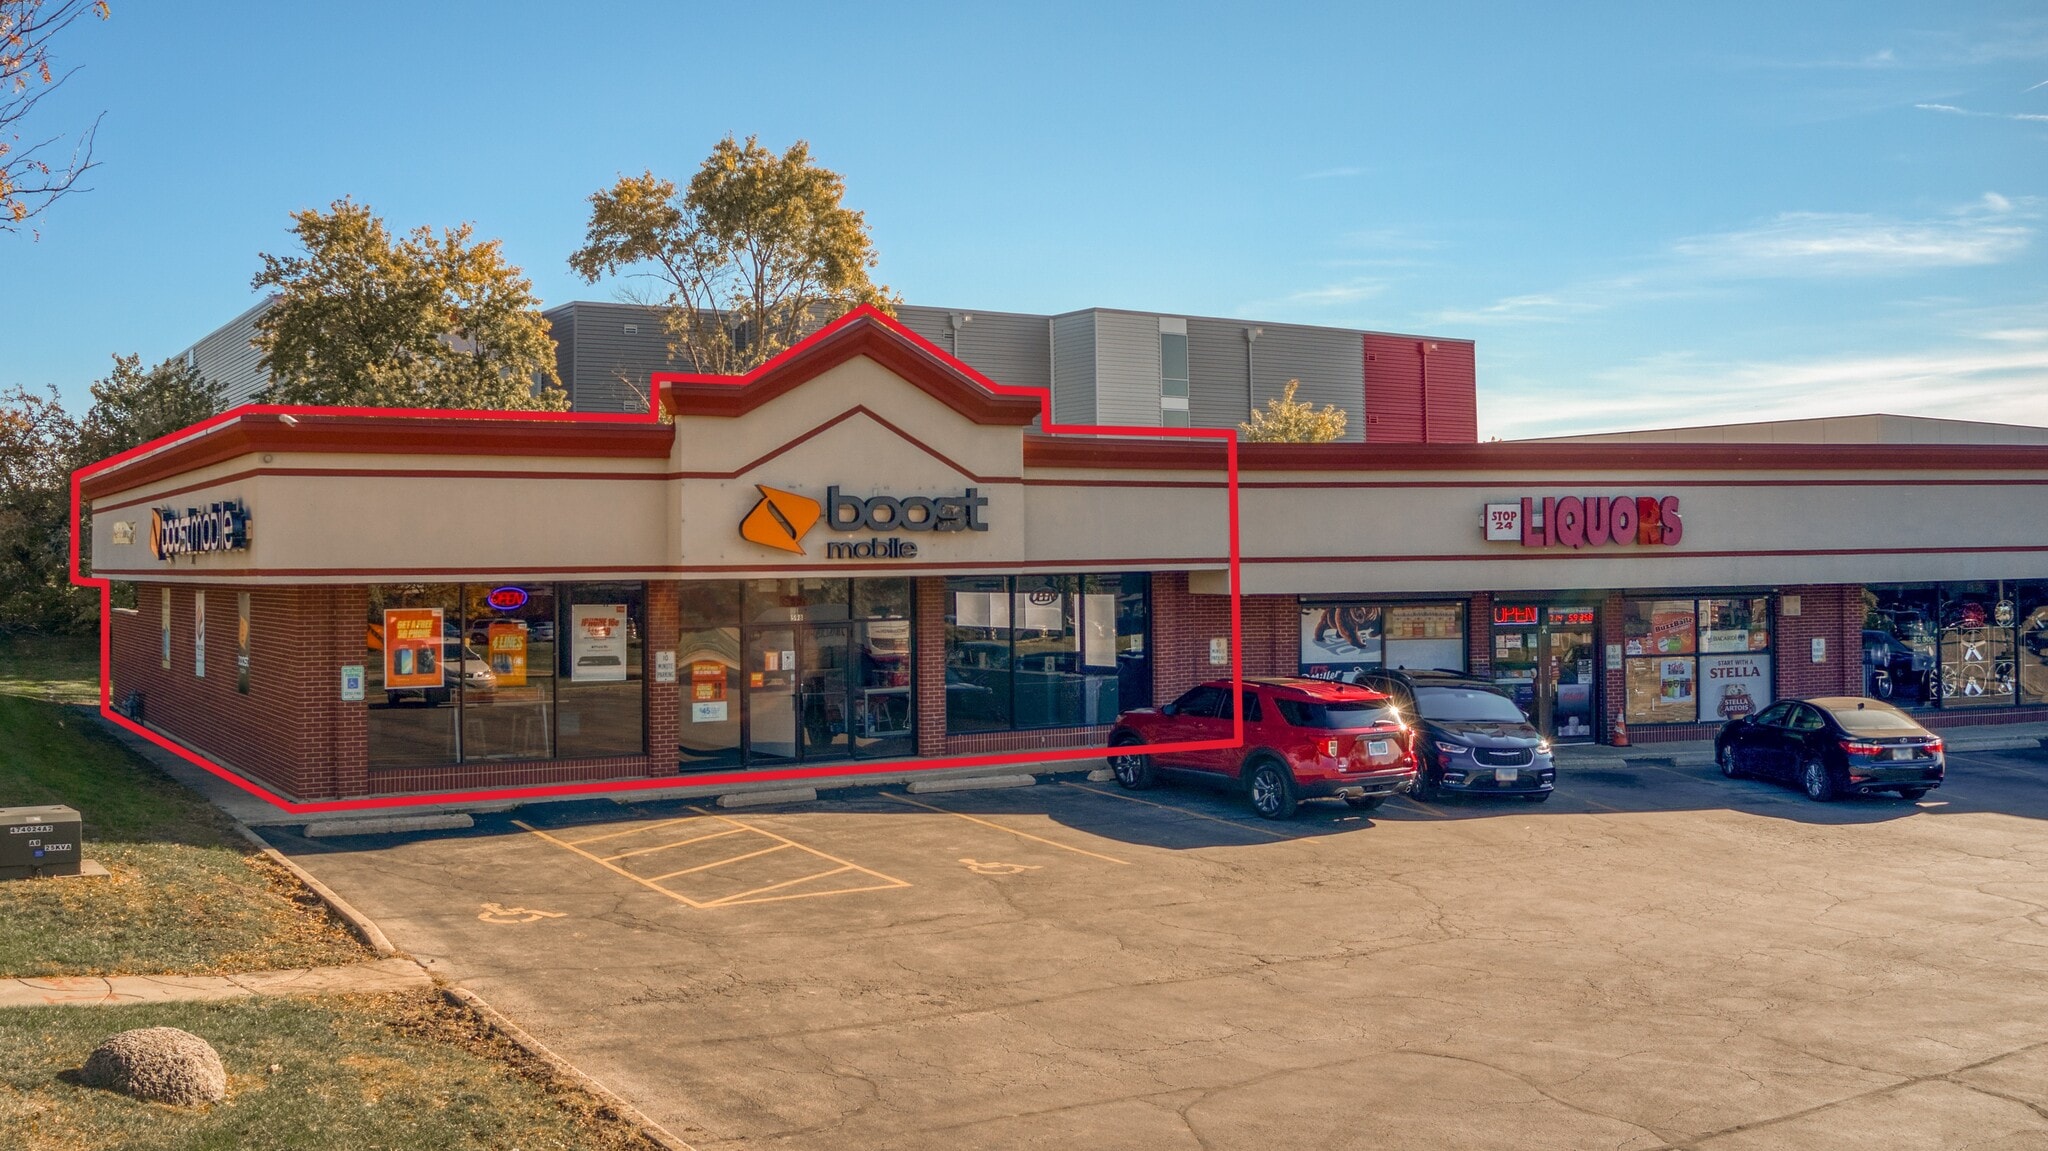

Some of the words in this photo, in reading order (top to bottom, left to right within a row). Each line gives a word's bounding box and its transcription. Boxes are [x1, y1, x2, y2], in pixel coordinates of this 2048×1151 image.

[827, 485, 989, 532] boost
[1491, 511, 1517, 521] STOP
[1495, 521, 1513, 530] 24
[1521, 495, 1683, 549] LIQUORS
[827, 537, 918, 559] mobile
[491, 591, 524, 605] OPEN
[1494, 605, 1538, 623] OPEN
[397, 620, 411, 630] GET
[499, 634, 524, 650] LINES
[1710, 666, 1761, 679] STELLA
